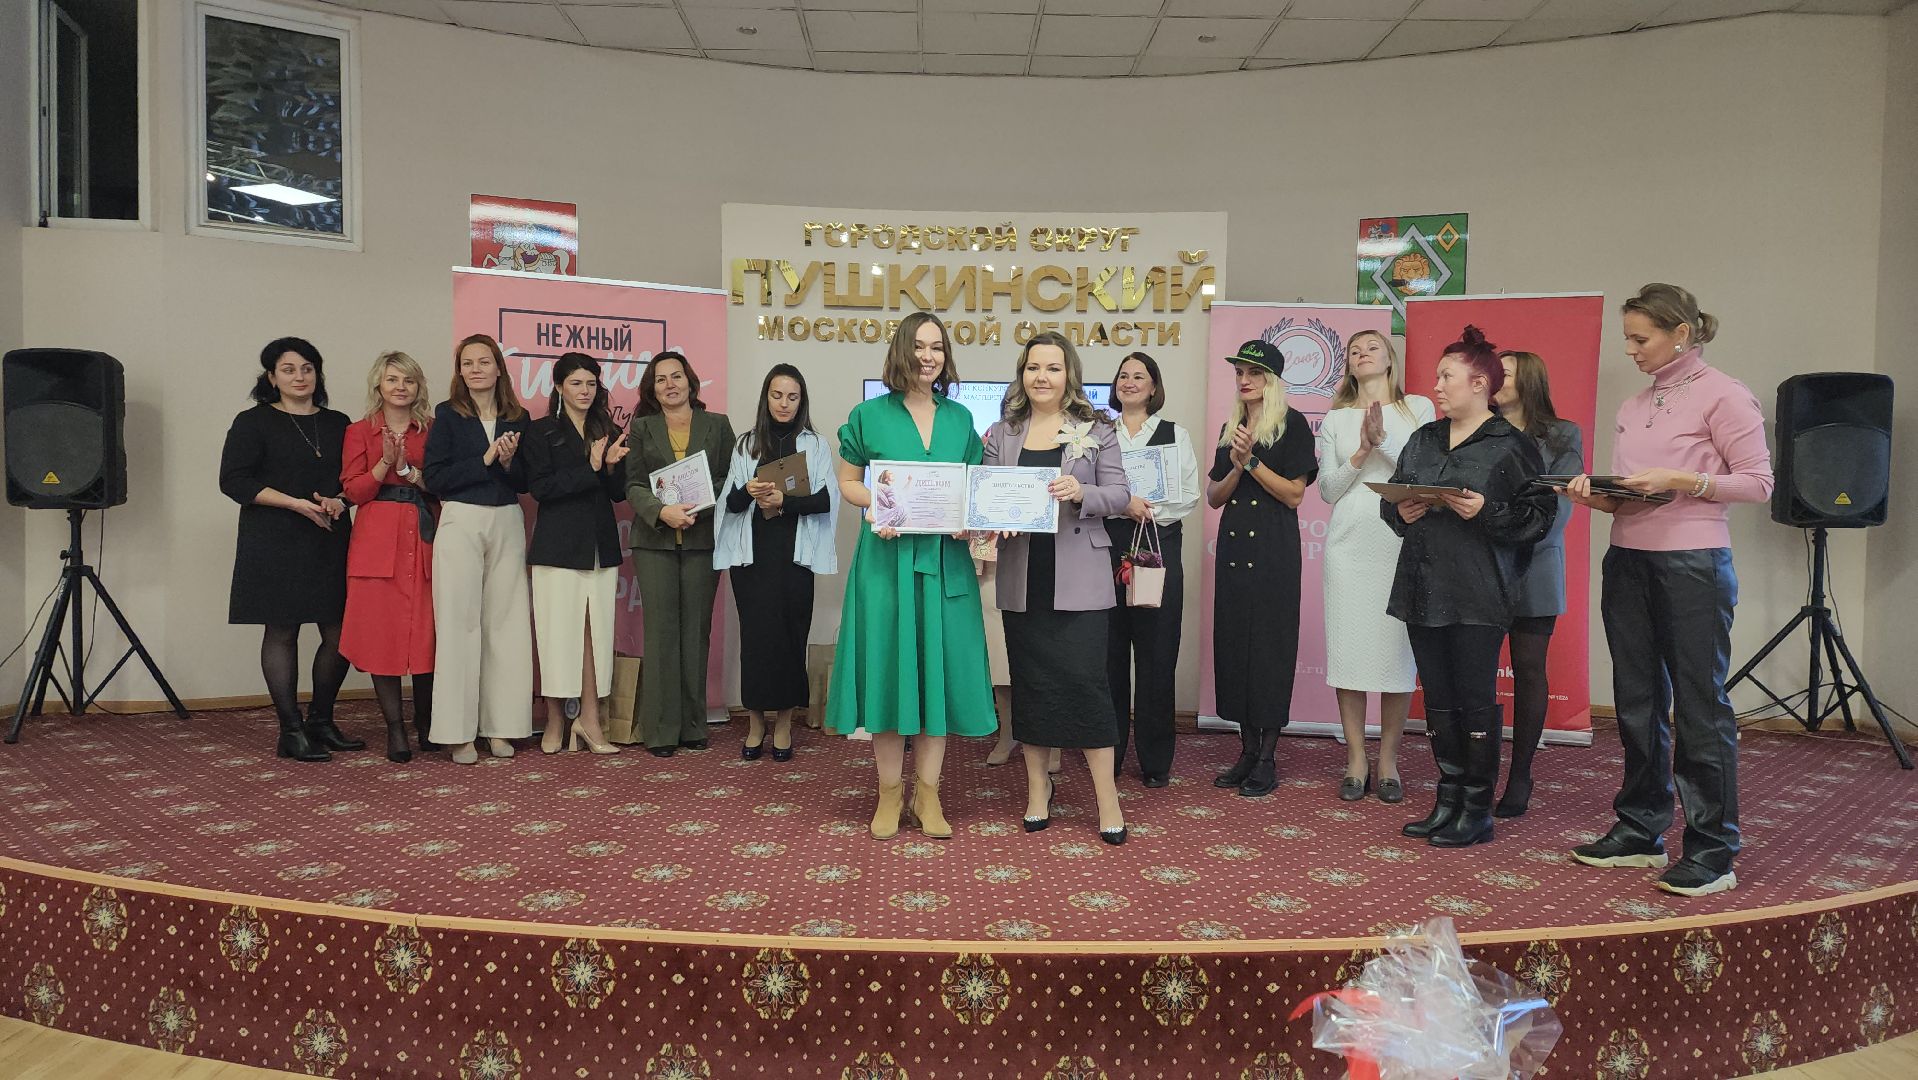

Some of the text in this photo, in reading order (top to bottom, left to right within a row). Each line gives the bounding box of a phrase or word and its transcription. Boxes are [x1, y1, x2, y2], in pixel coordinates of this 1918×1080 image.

[804, 221, 1140, 255] ГОРОДСКОЙ ОКРУГ
[730, 250, 1216, 313] ПУШКИНСКИЙ
[536, 323, 632, 352] НЕЖНЫЙ
[757, 314, 1001, 346] МОСКОВОЙ
